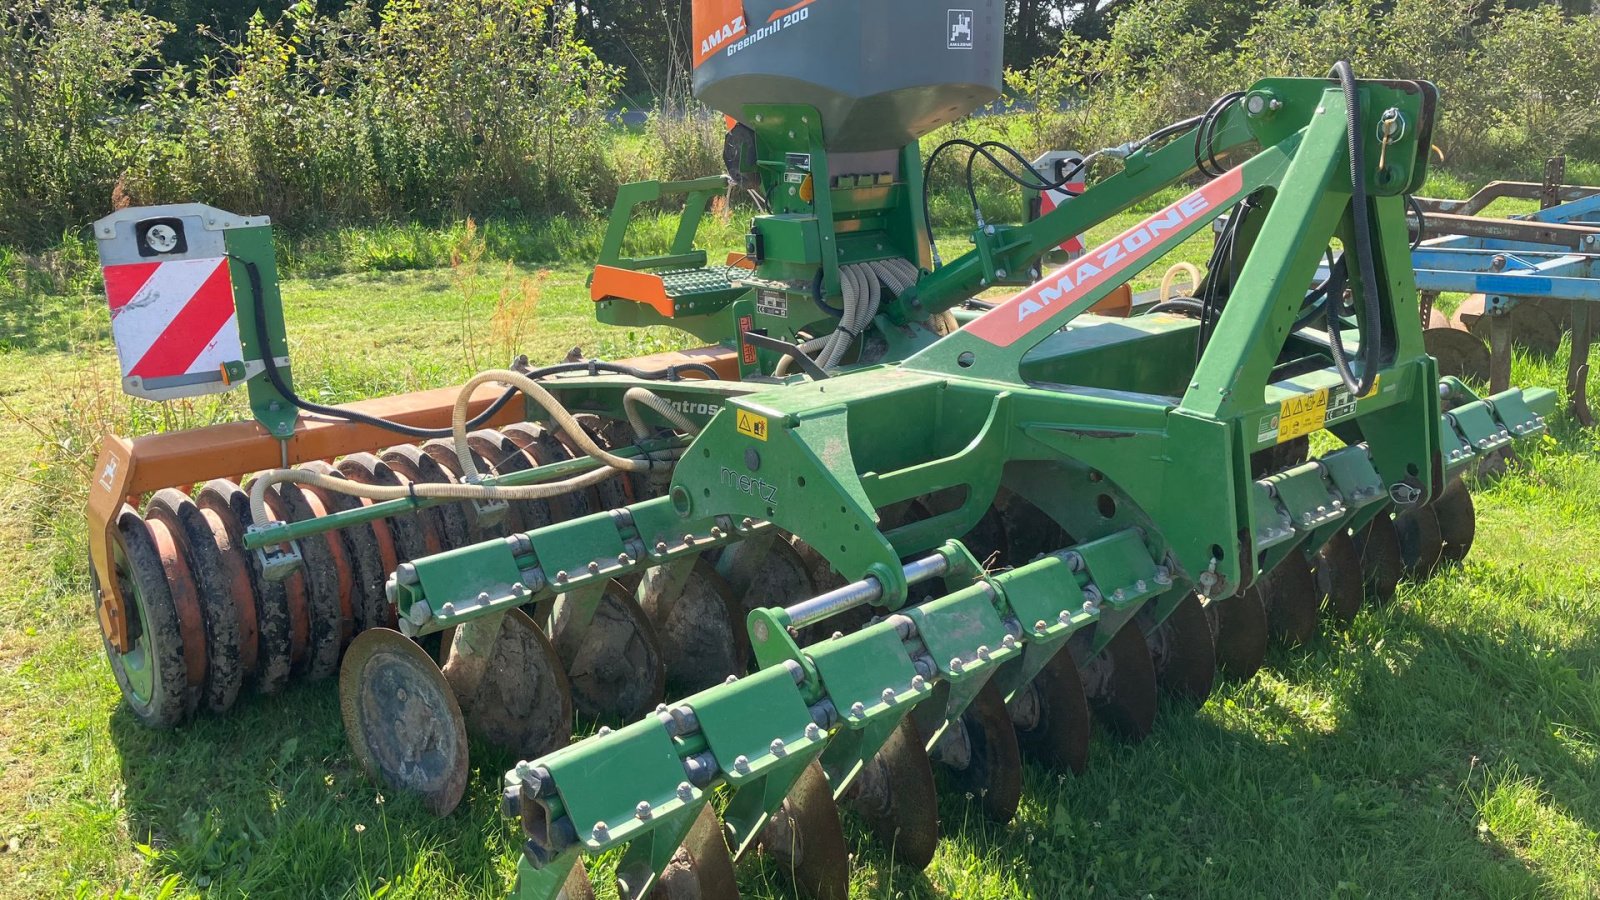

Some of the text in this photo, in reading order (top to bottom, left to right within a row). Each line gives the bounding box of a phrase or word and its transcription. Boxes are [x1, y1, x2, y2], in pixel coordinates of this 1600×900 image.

[701, 15, 746, 56] AMAZ
[727, 7, 809, 57] GreenDrill 200
[1018, 191, 1209, 323] AMAZONE
[720, 466, 777, 505] mertz
